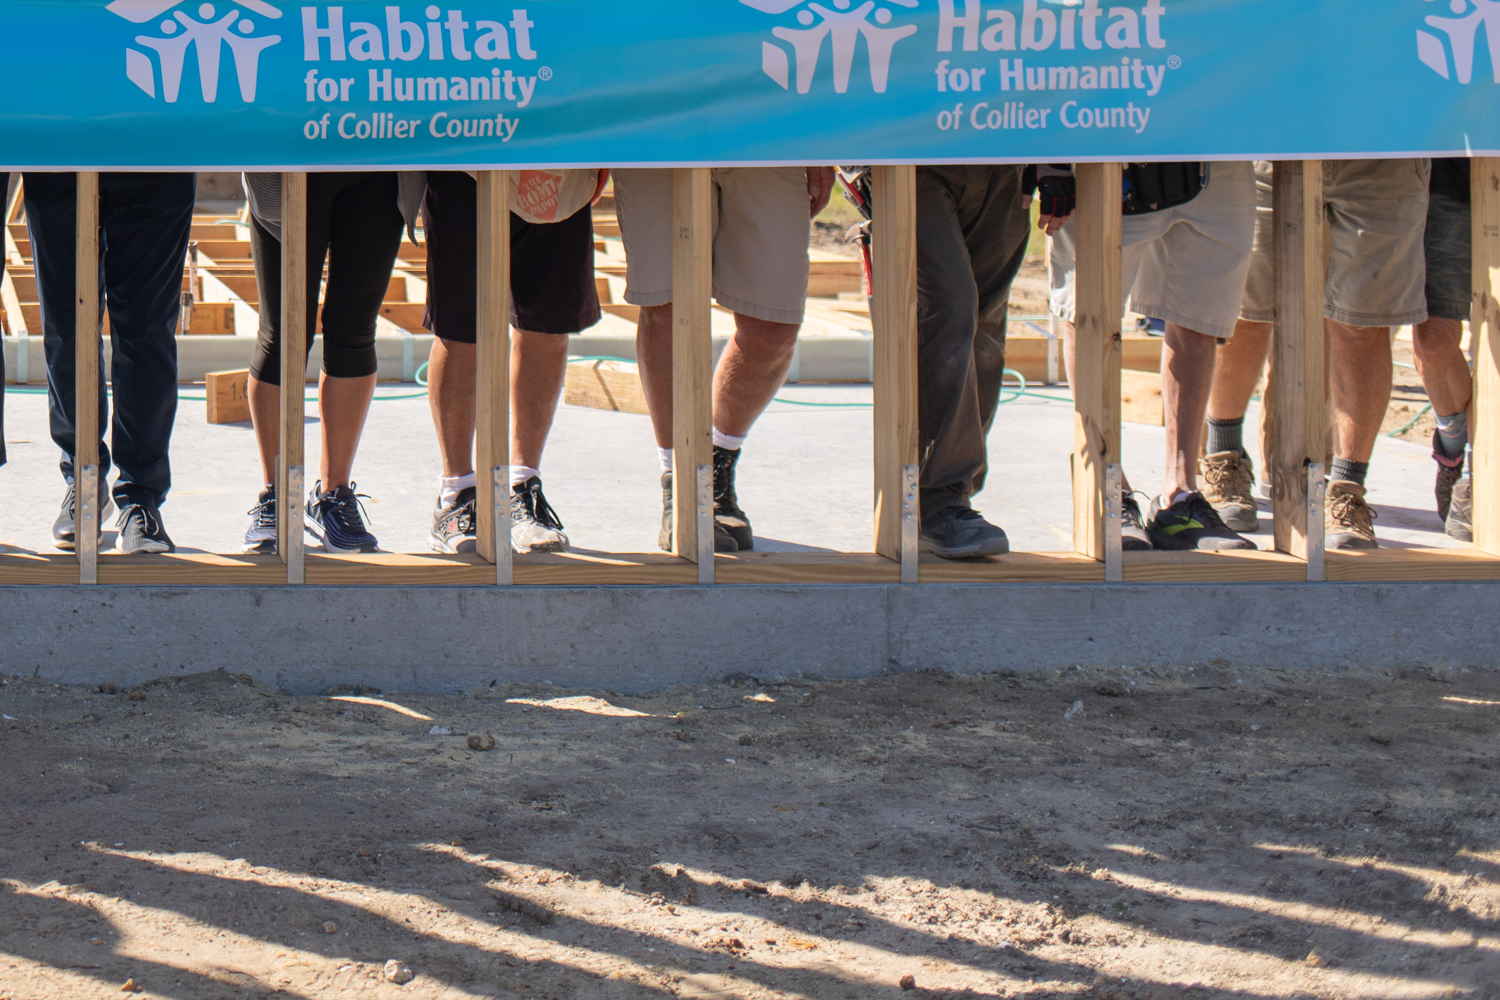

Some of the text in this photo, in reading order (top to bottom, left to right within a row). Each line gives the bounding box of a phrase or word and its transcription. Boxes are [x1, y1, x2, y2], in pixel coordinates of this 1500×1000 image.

[302, 6, 537, 62] Habitat
[304, 68, 355, 102] for
[935, 59, 986, 92] for
[304, 112, 520, 143] of Collier County
[937, 101, 1151, 134] of Collier County
[524, 175, 541, 190] THE
